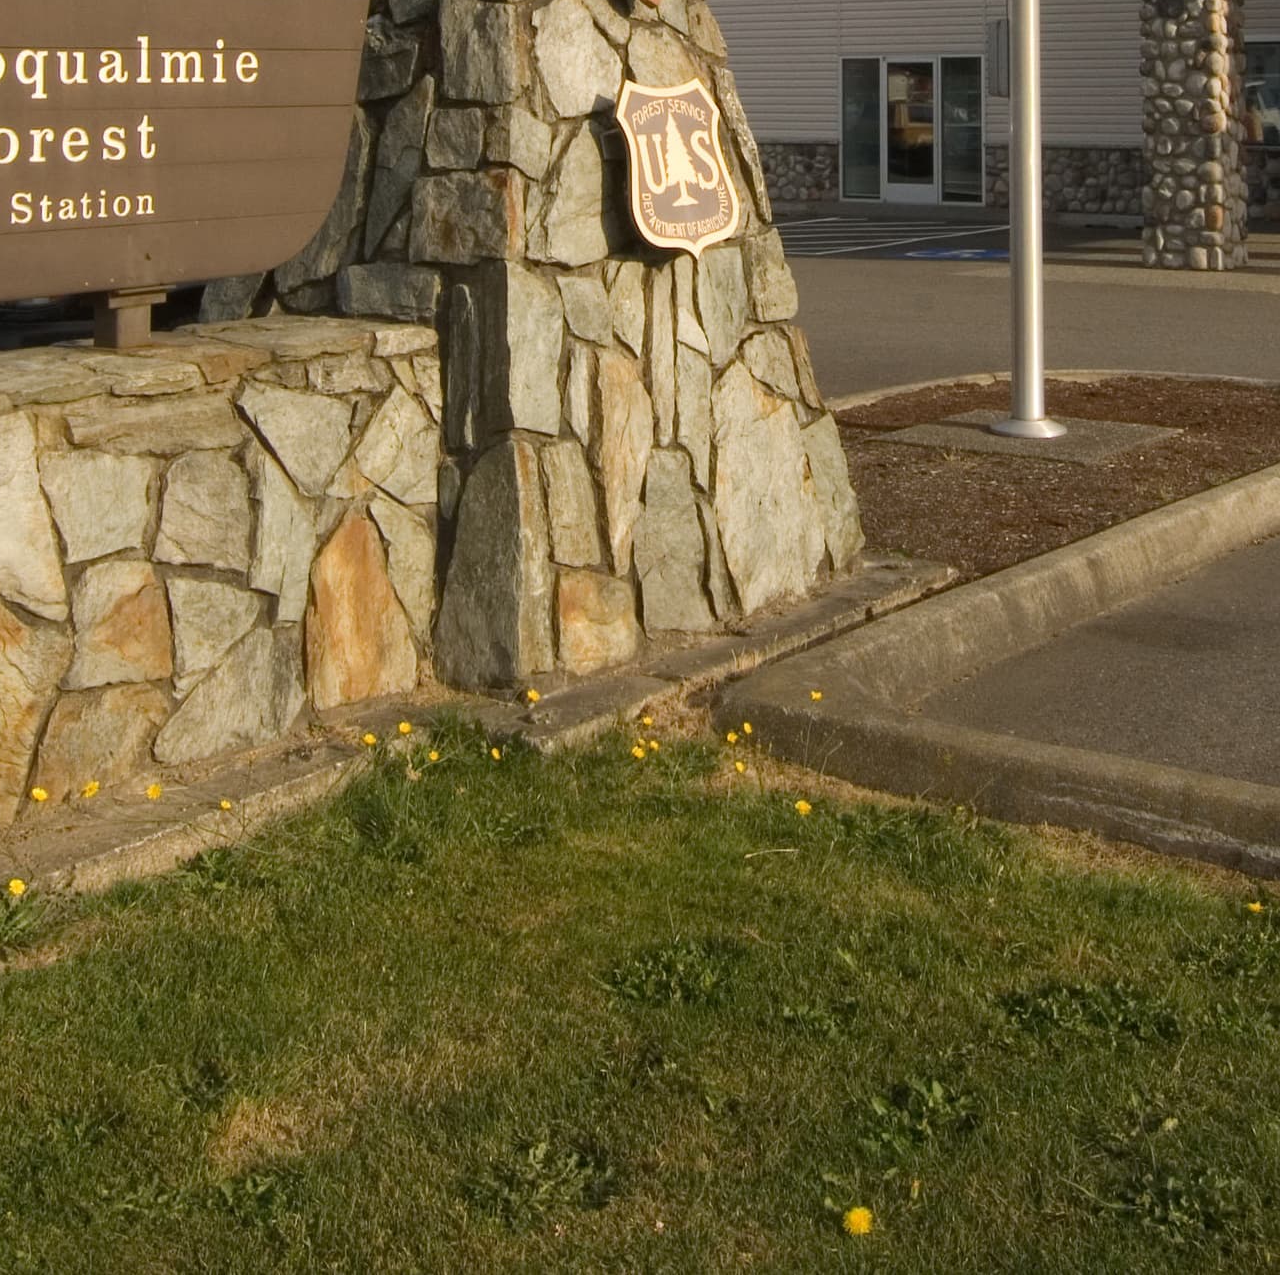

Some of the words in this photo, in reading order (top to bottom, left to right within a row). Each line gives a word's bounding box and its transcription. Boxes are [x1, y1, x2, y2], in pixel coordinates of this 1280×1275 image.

[631, 99, 665, 130] FOREST
[668, 98, 708, 126] SERVICE
[10, 192, 155, 224] Station
[641, 192, 687, 238] DEPARTMENT
[687, 221, 698, 237] OF
[697, 182, 730, 236] AGRICULTURE
